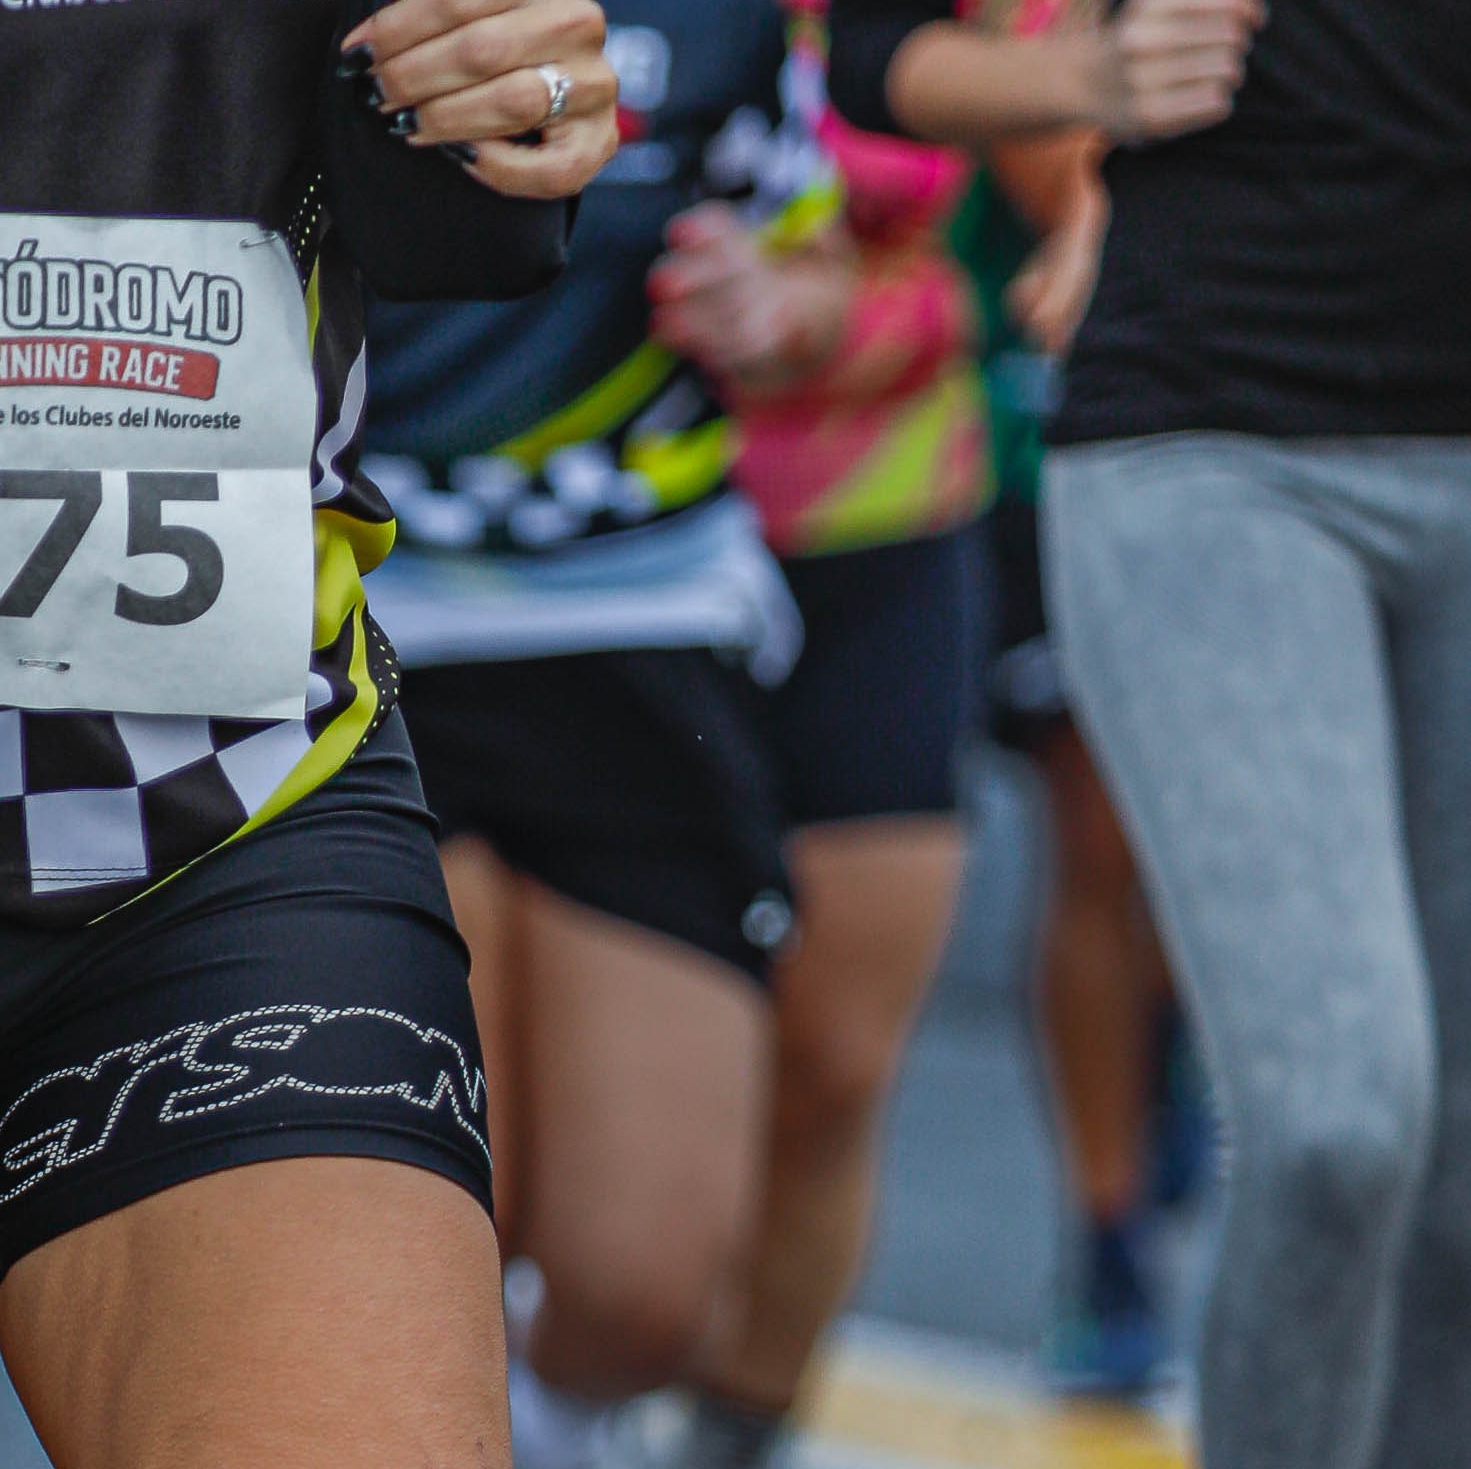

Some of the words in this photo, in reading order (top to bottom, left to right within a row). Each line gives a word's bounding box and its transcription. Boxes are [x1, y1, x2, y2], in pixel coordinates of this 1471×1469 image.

[99, 345, 184, 390] RACE
[11, 404, 41, 426] los
[45, 405, 113, 428] Clubes
[118, 406, 149, 428] del
[154, 407, 242, 431] Noroeste
